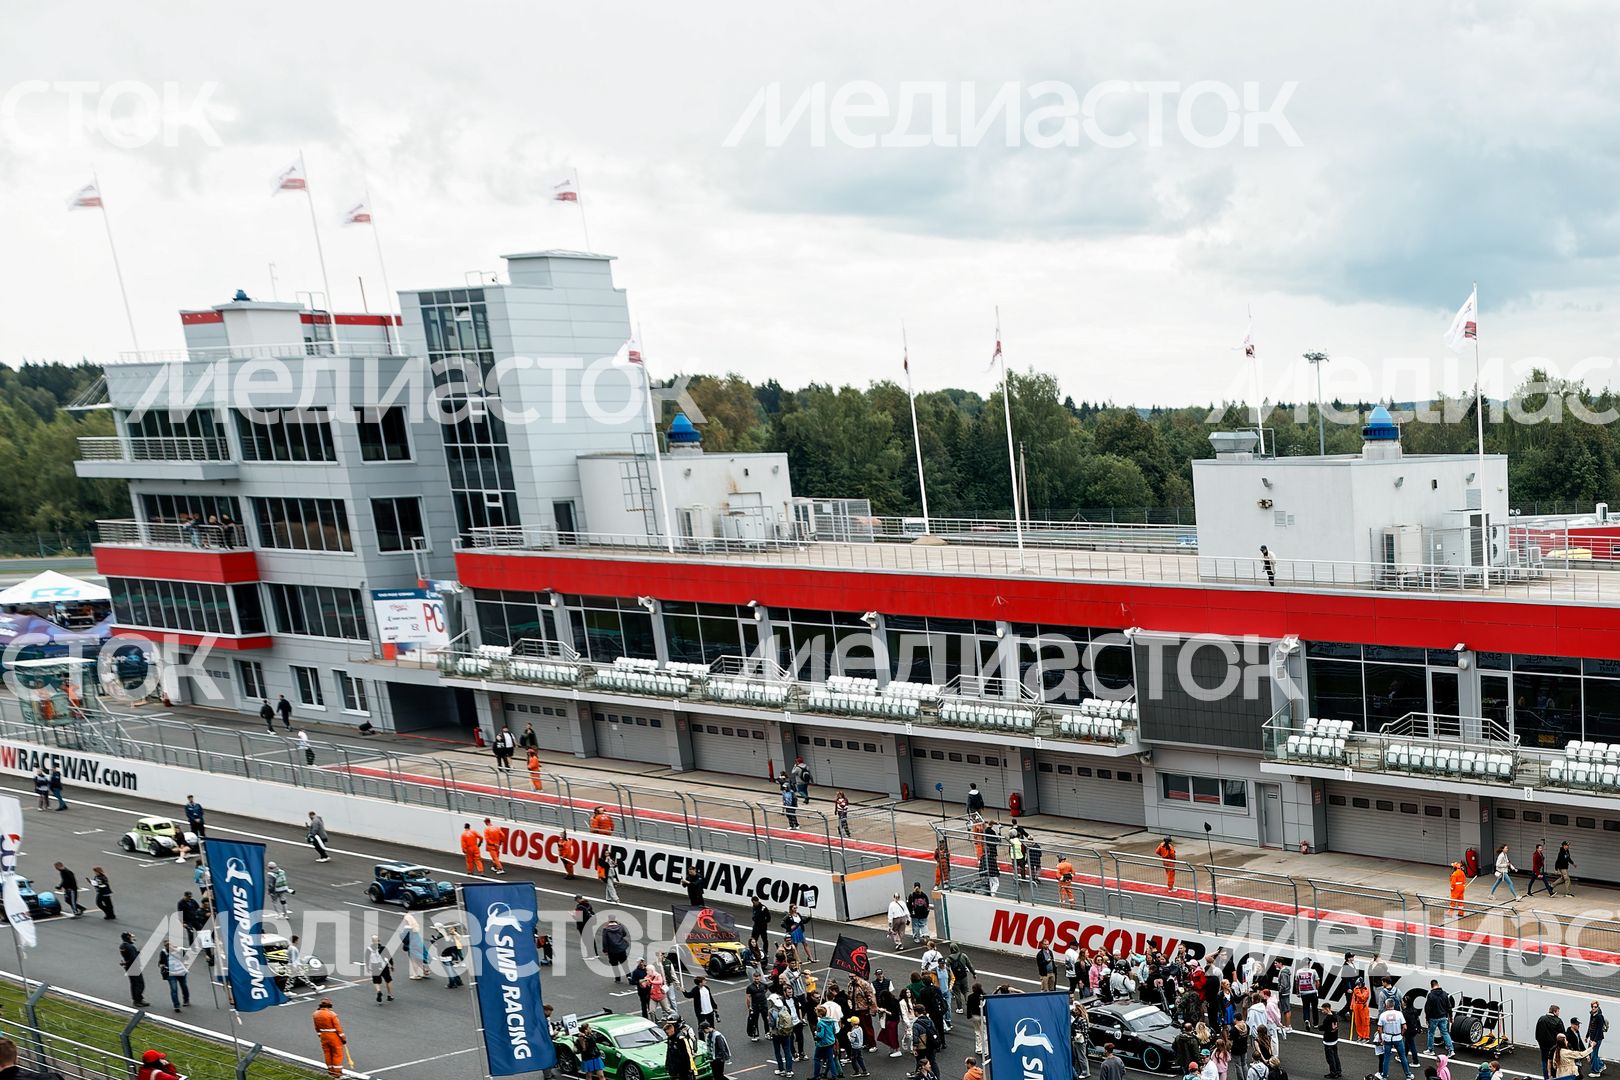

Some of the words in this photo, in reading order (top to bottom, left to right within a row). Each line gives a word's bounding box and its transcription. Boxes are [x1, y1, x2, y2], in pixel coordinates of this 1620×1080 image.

[232, 884, 251, 929] SMP
[238, 930, 269, 1001] RACING
[493, 932, 519, 982] SMP
[500, 984, 533, 1061] RACING
